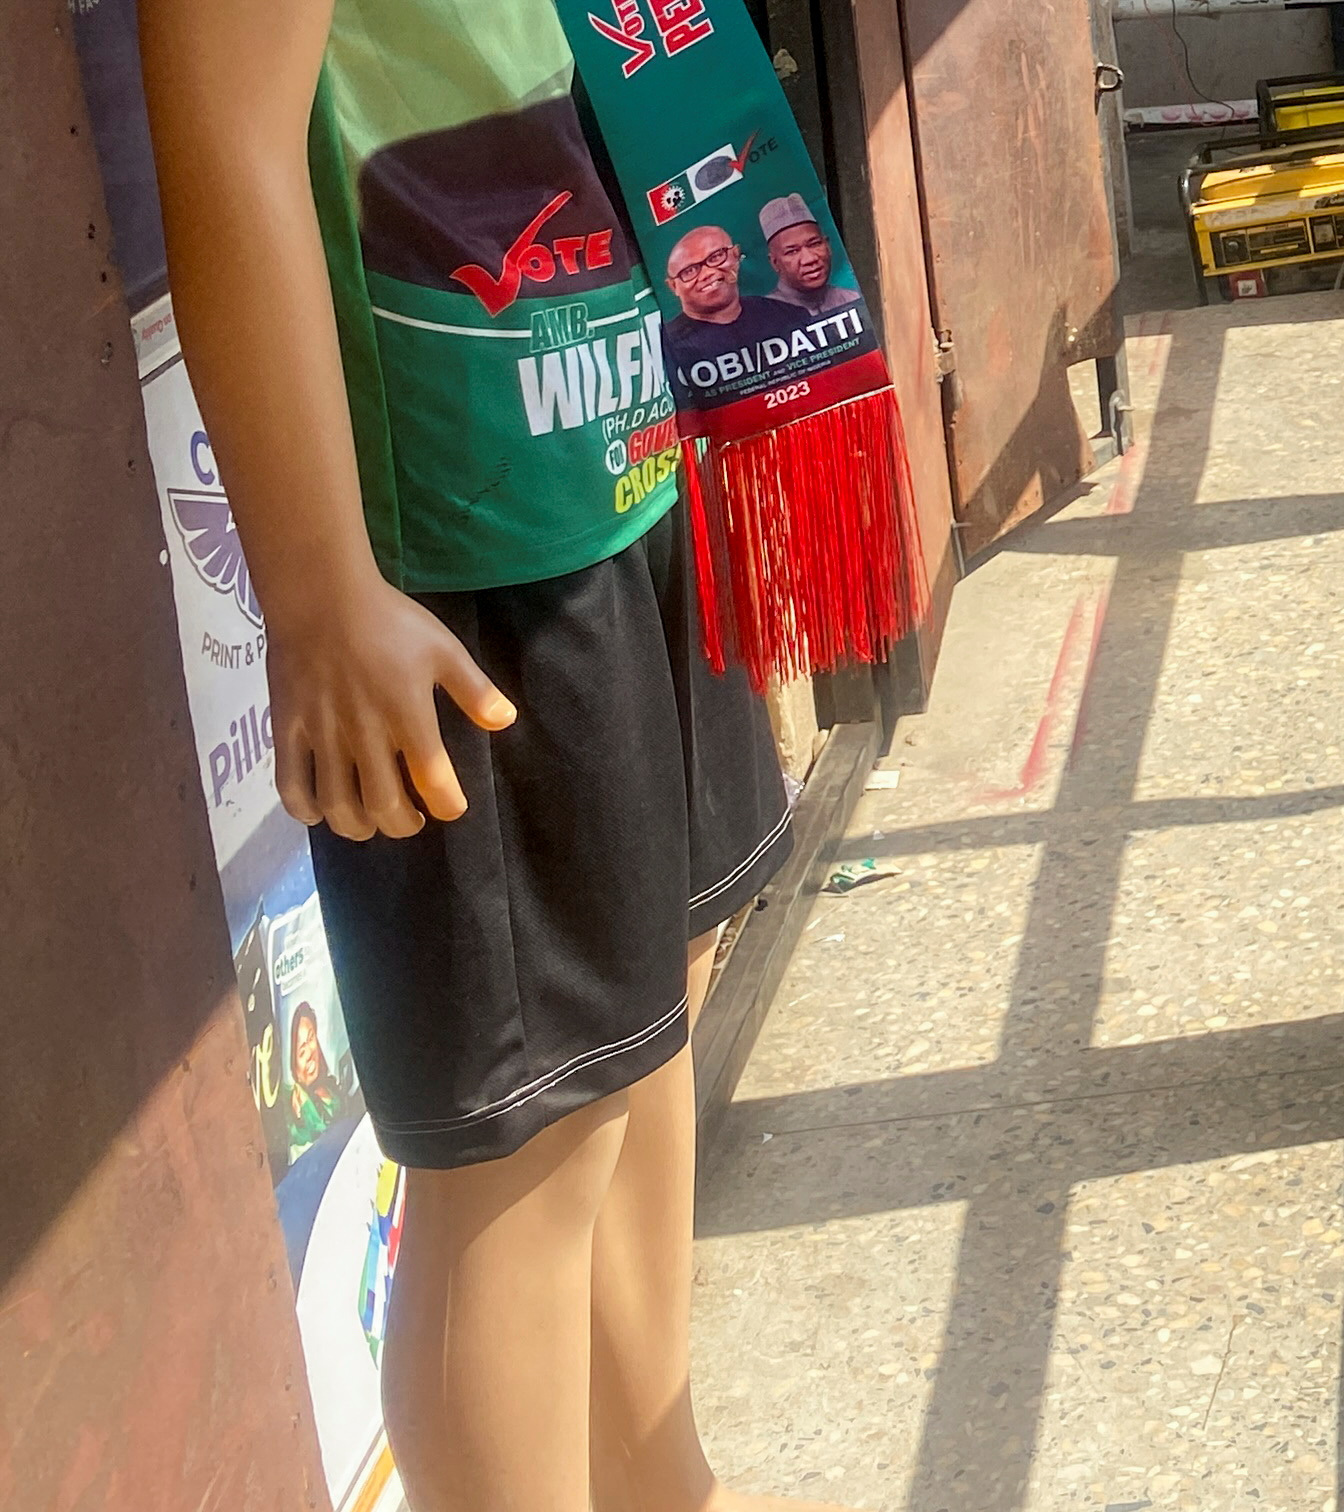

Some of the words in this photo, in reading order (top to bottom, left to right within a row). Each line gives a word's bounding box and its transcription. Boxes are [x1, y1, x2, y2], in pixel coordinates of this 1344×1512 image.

[450, 191, 613, 318] VOTE
[530, 303, 595, 352] AMB.
[690, 308, 864, 388] OBI/DATTI
[719, 371, 772, 395] PRESIDENT
[786, 359, 809, 371] VICE
[810, 337, 860, 362] PRESIDENT
[764, 381, 811, 410] 2023
[202, 632, 241, 670] PRINT
[245, 642, 255, 666] &
[275, 948, 304, 981] others
